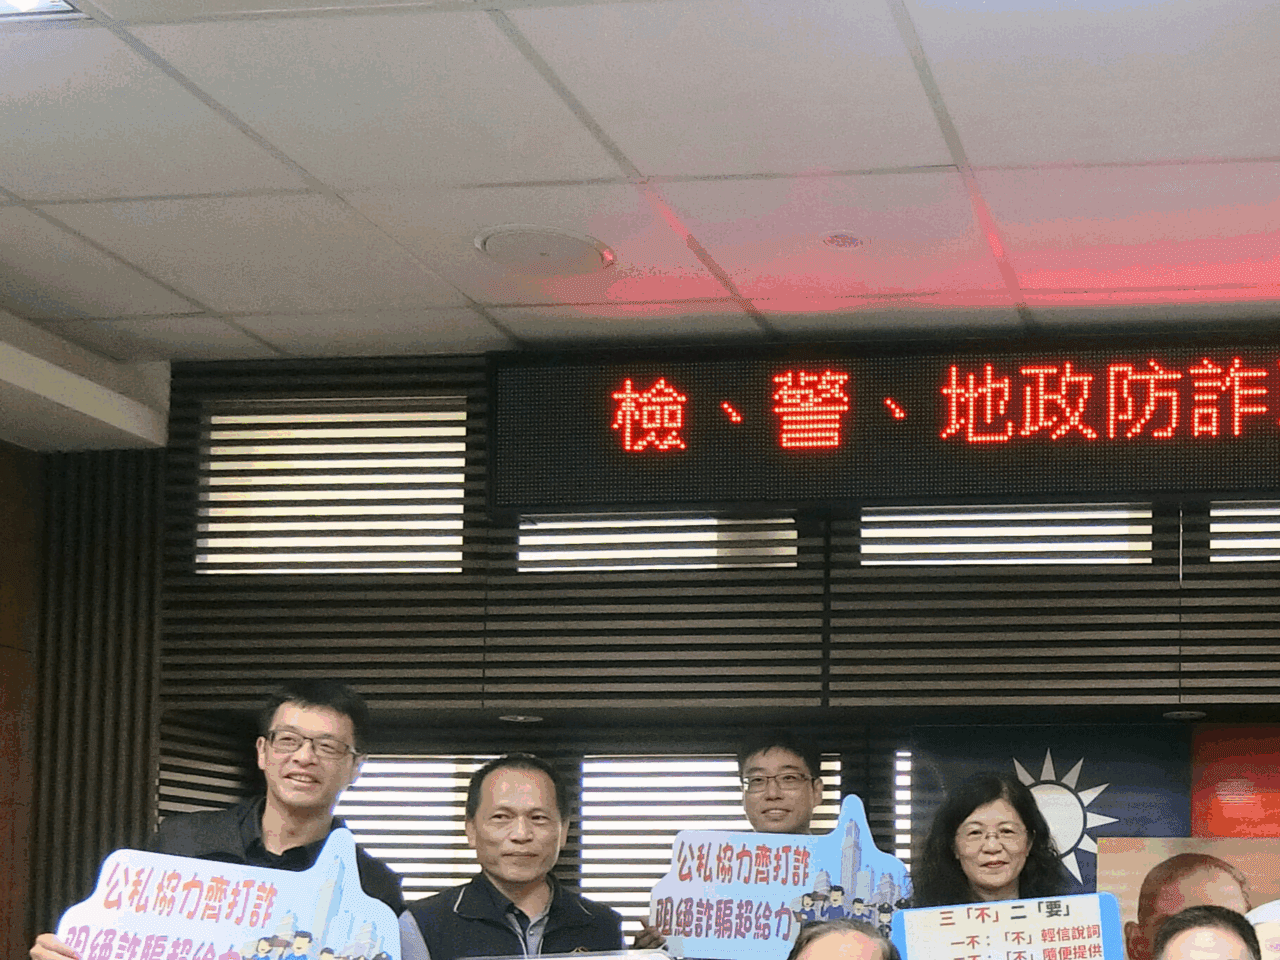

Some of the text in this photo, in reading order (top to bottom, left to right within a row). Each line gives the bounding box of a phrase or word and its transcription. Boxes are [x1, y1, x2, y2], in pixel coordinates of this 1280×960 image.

[677, 840, 811, 887] 公私協力齊打詐
[103, 861, 279, 929] 公私協力齊打詐
[655, 896, 793, 942] 阻絕詐騙超給力
